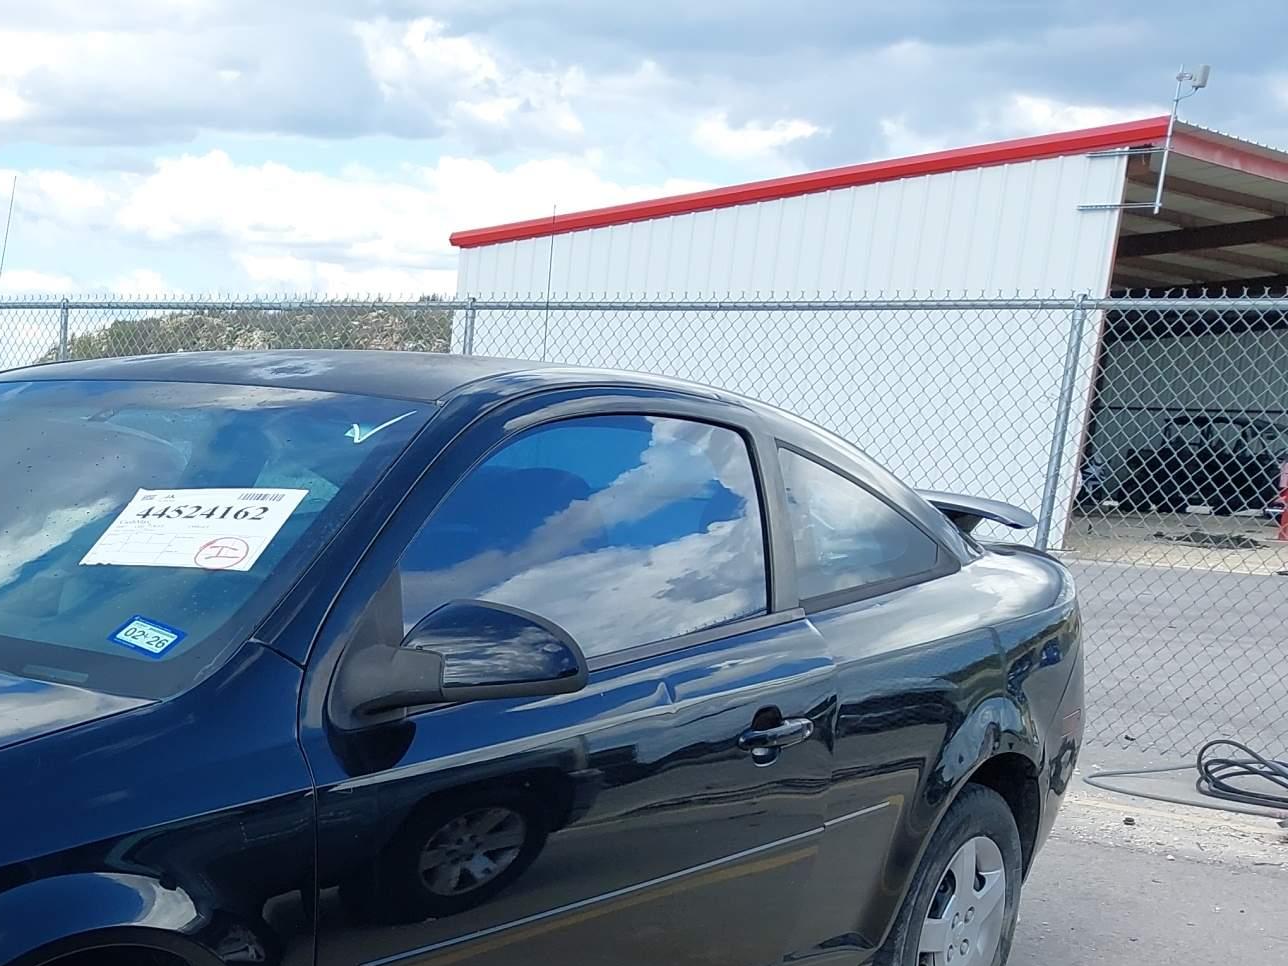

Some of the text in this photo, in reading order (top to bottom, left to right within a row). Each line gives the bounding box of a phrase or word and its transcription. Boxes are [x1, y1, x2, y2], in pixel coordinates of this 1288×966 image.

[135, 504, 270, 521] 44524162
[123, 627, 169, 649] 02 26
